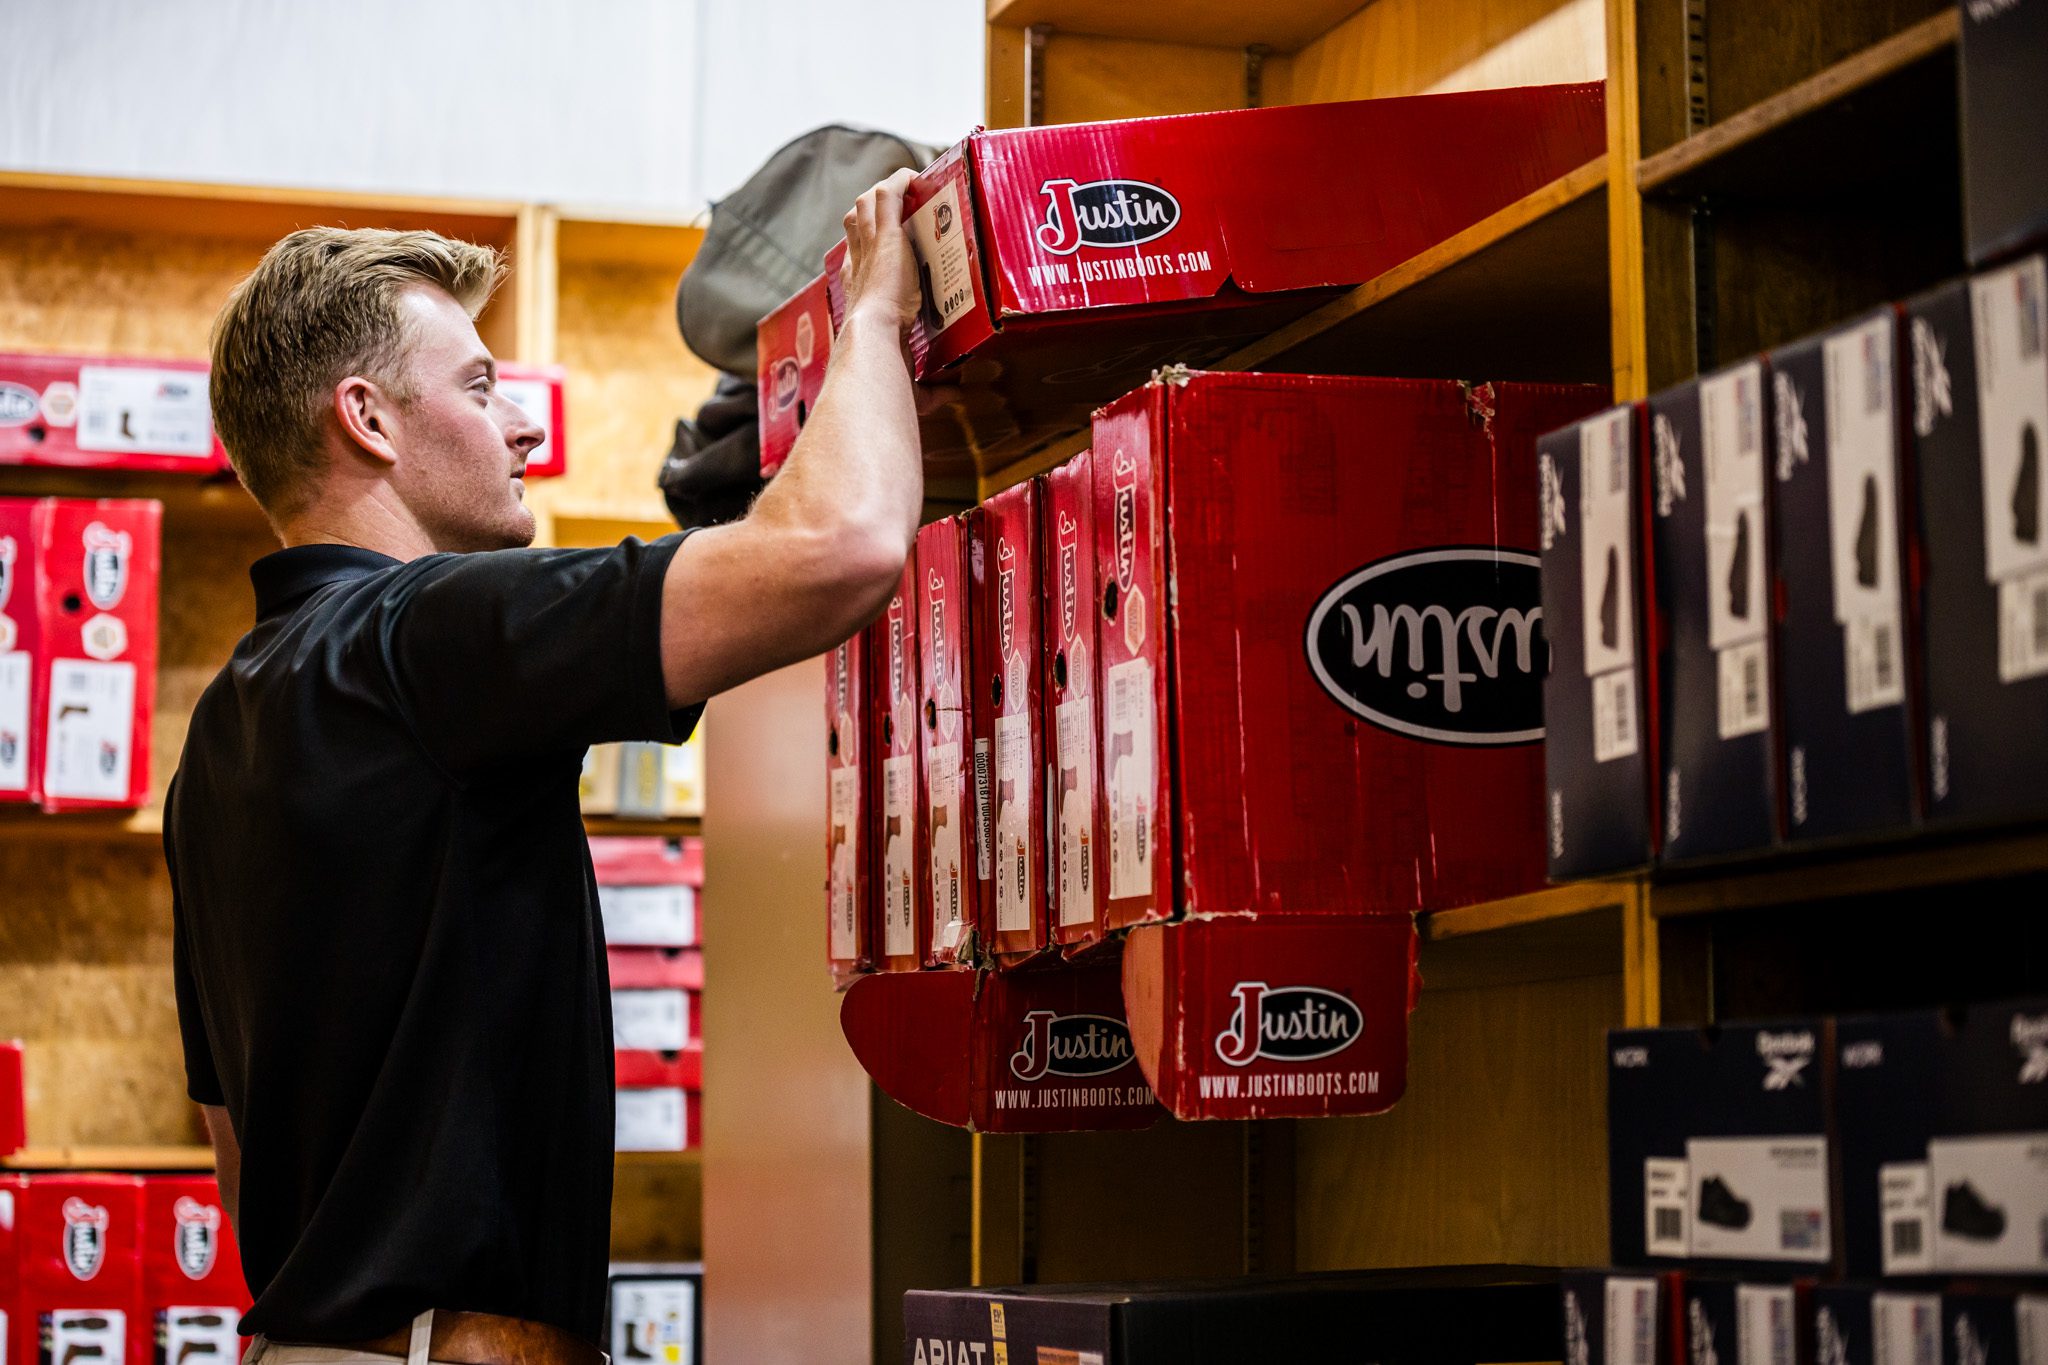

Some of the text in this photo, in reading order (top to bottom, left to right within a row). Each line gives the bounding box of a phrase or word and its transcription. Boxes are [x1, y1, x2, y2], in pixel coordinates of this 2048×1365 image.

[1037, 179, 1169, 255] Justin
[1028, 251, 1212, 288] WWW.JUSTINBOOTS.COM
[1113, 449, 1137, 588] Justin
[997, 537, 1016, 658] Justin
[1058, 511, 1077, 636] Justin
[1342, 604, 1552, 713] ustin
[1010, 1010, 1128, 1082] Justin
[1215, 981, 1350, 1067] Justin
[995, 1087, 1155, 1111] WWW.JUSTINBOOTS.COM
[1199, 1072, 1380, 1100] WWW.JUSTINBOOTS.COM
